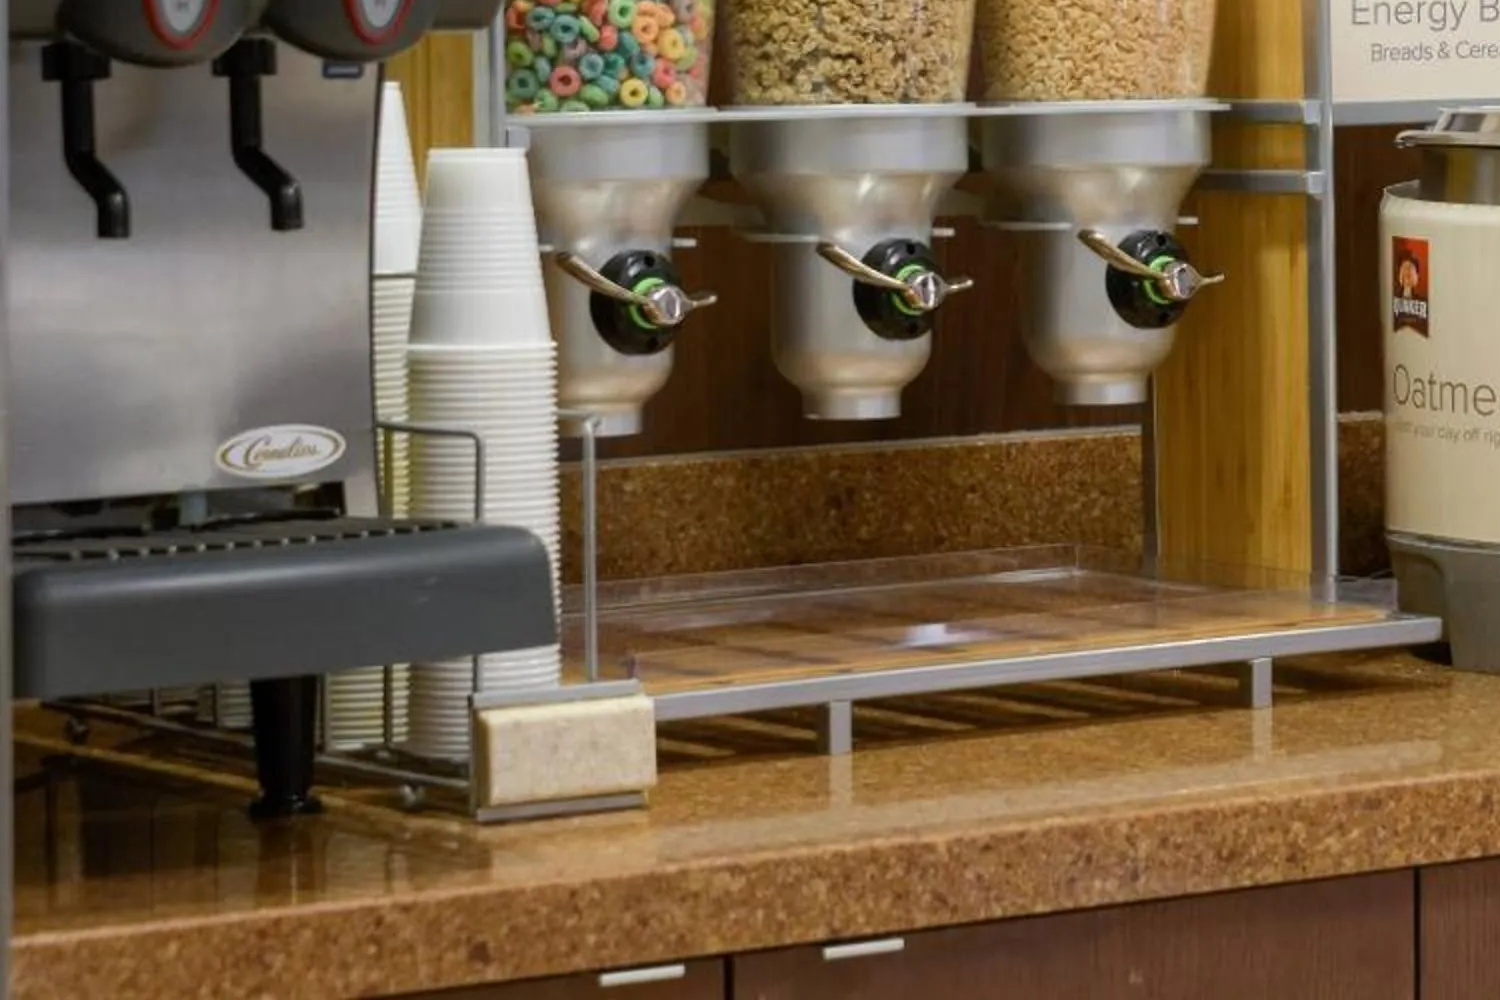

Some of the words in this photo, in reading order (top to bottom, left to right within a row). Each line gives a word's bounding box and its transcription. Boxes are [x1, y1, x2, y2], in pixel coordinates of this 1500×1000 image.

[1370, 42, 1433, 63] Breads
[1437, 42, 1451, 60] &
[1393, 297, 1428, 319] QUAKER
